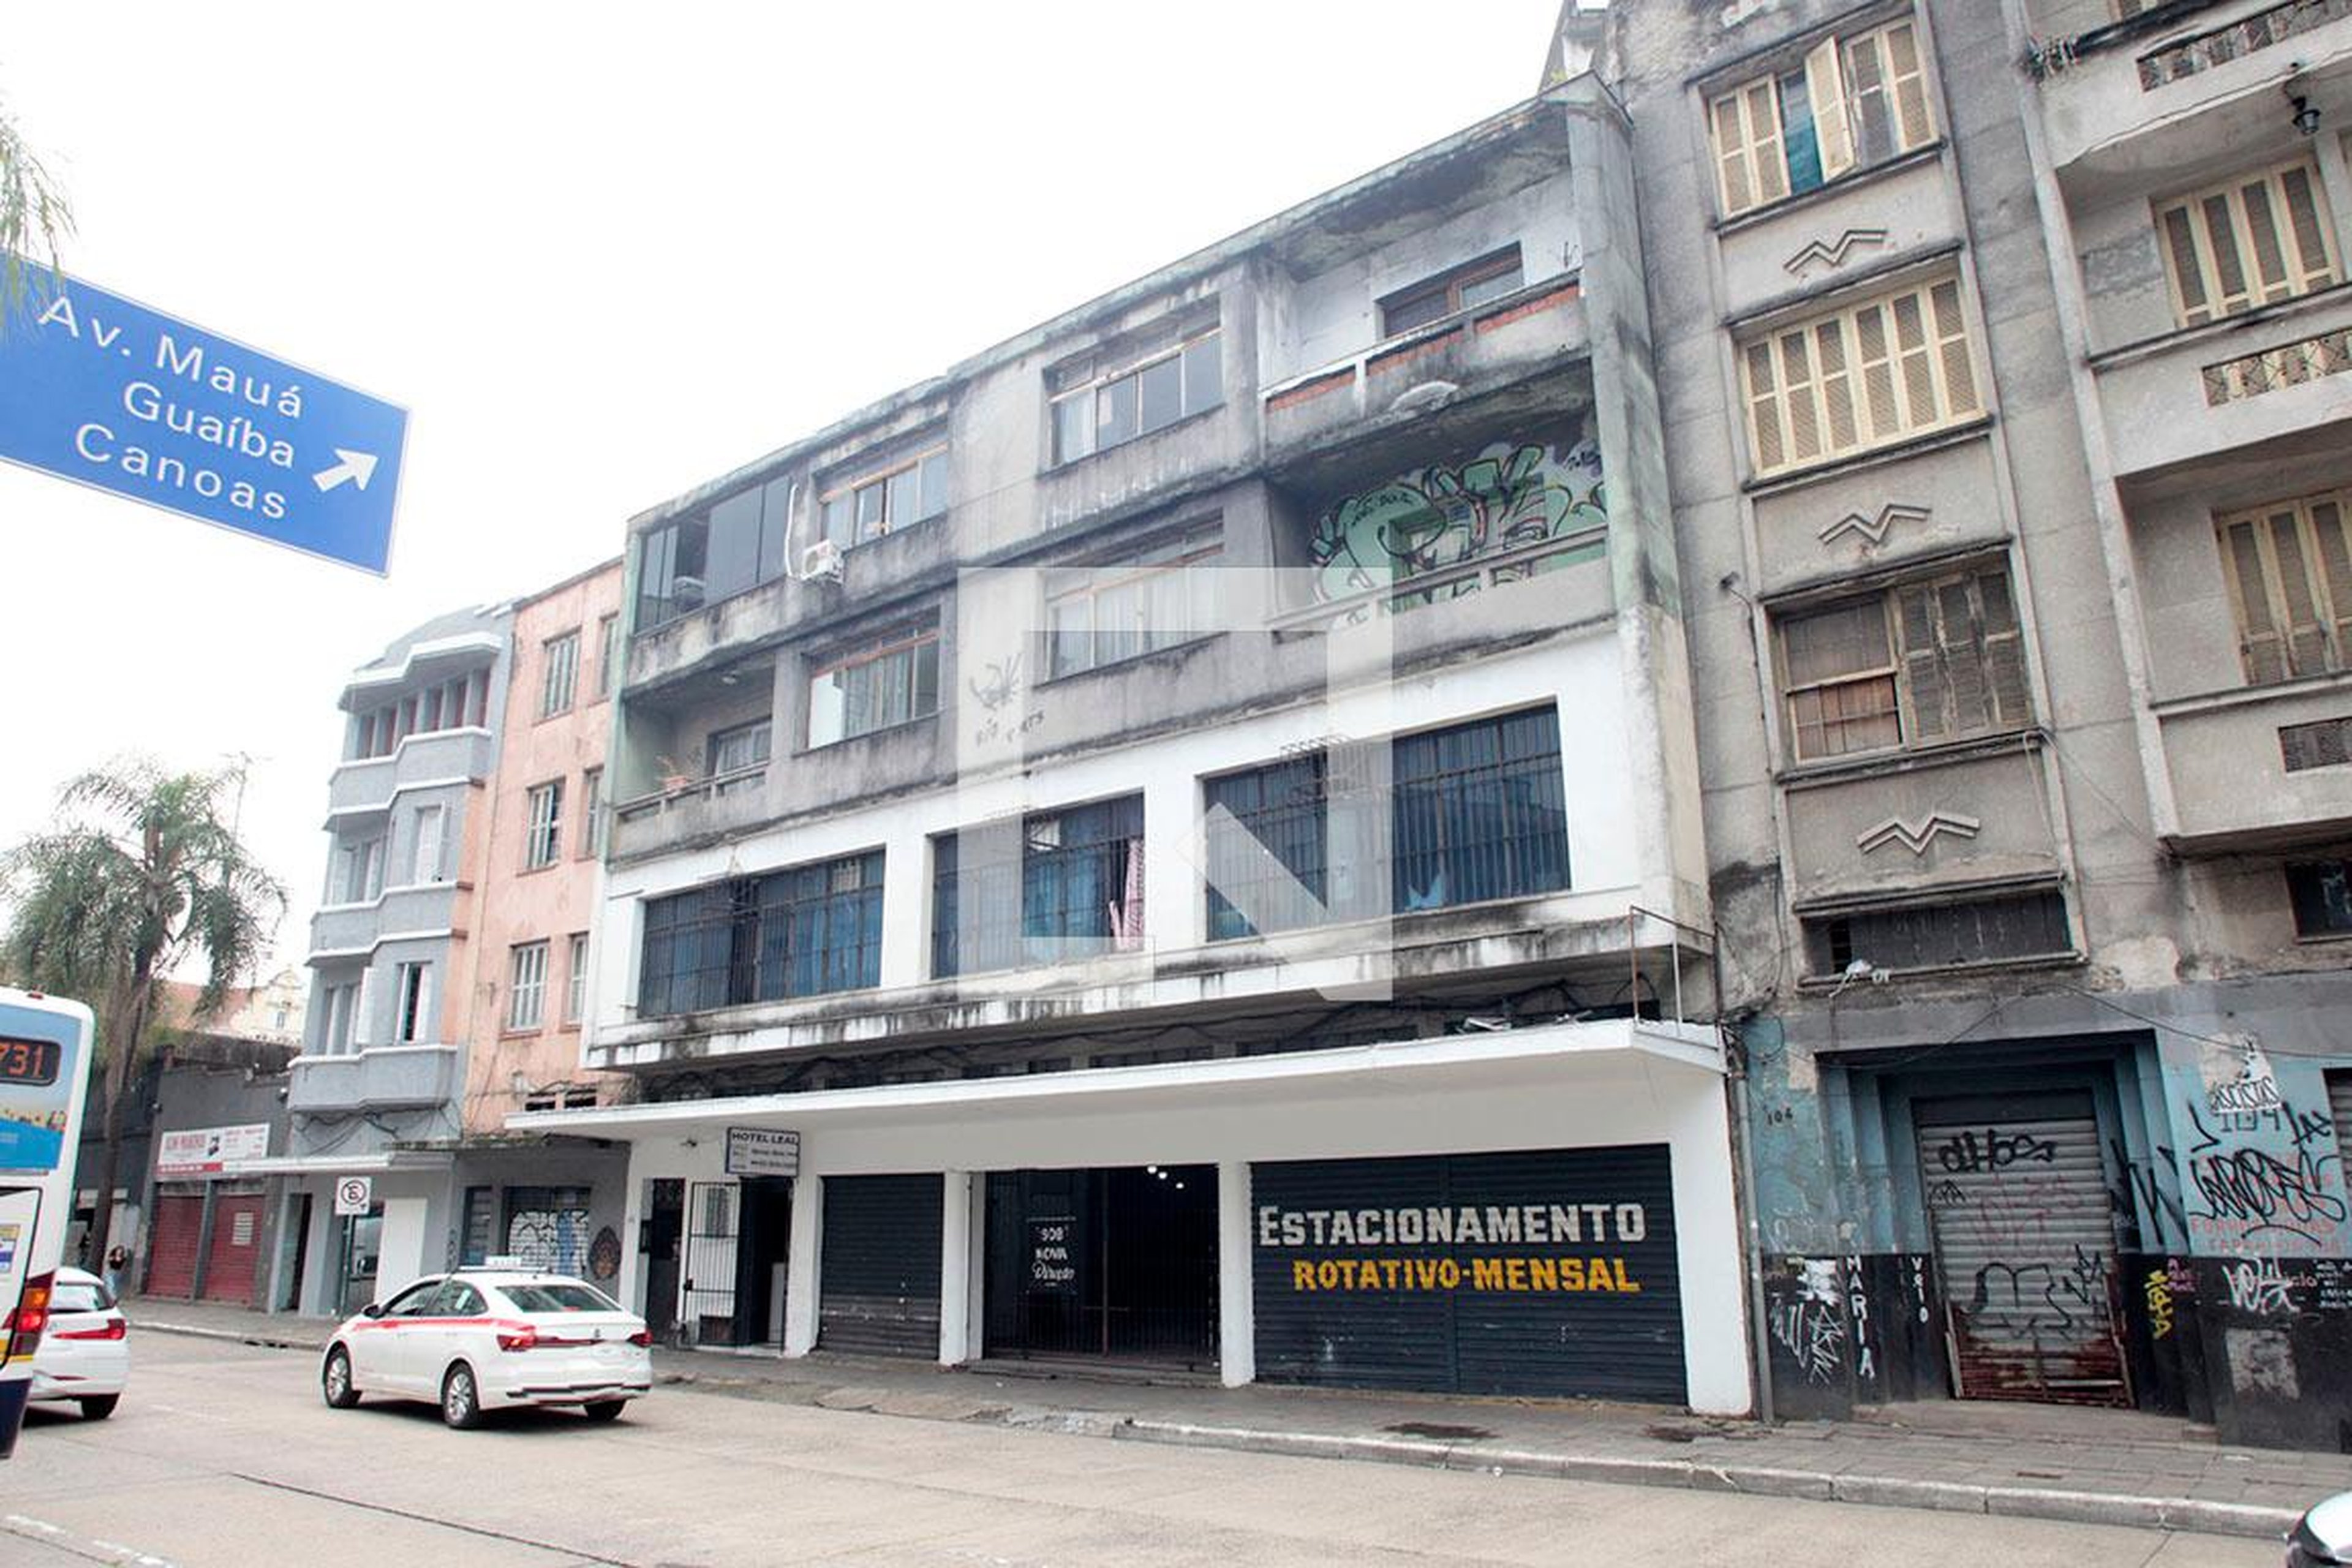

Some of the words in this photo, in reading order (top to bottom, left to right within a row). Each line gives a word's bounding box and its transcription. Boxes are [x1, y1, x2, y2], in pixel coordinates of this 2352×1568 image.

[38, 294, 130, 357] Av.
[156, 334, 304, 418] Mauá
[123, 381, 295, 469] Guaíba
[75, 423, 286, 519] Canoas
[732, 1132, 769, 1144] HOTEL
[771, 1134, 796, 1145] LEAL
[1259, 1202, 1646, 1247] ESTACIONAMENTO
